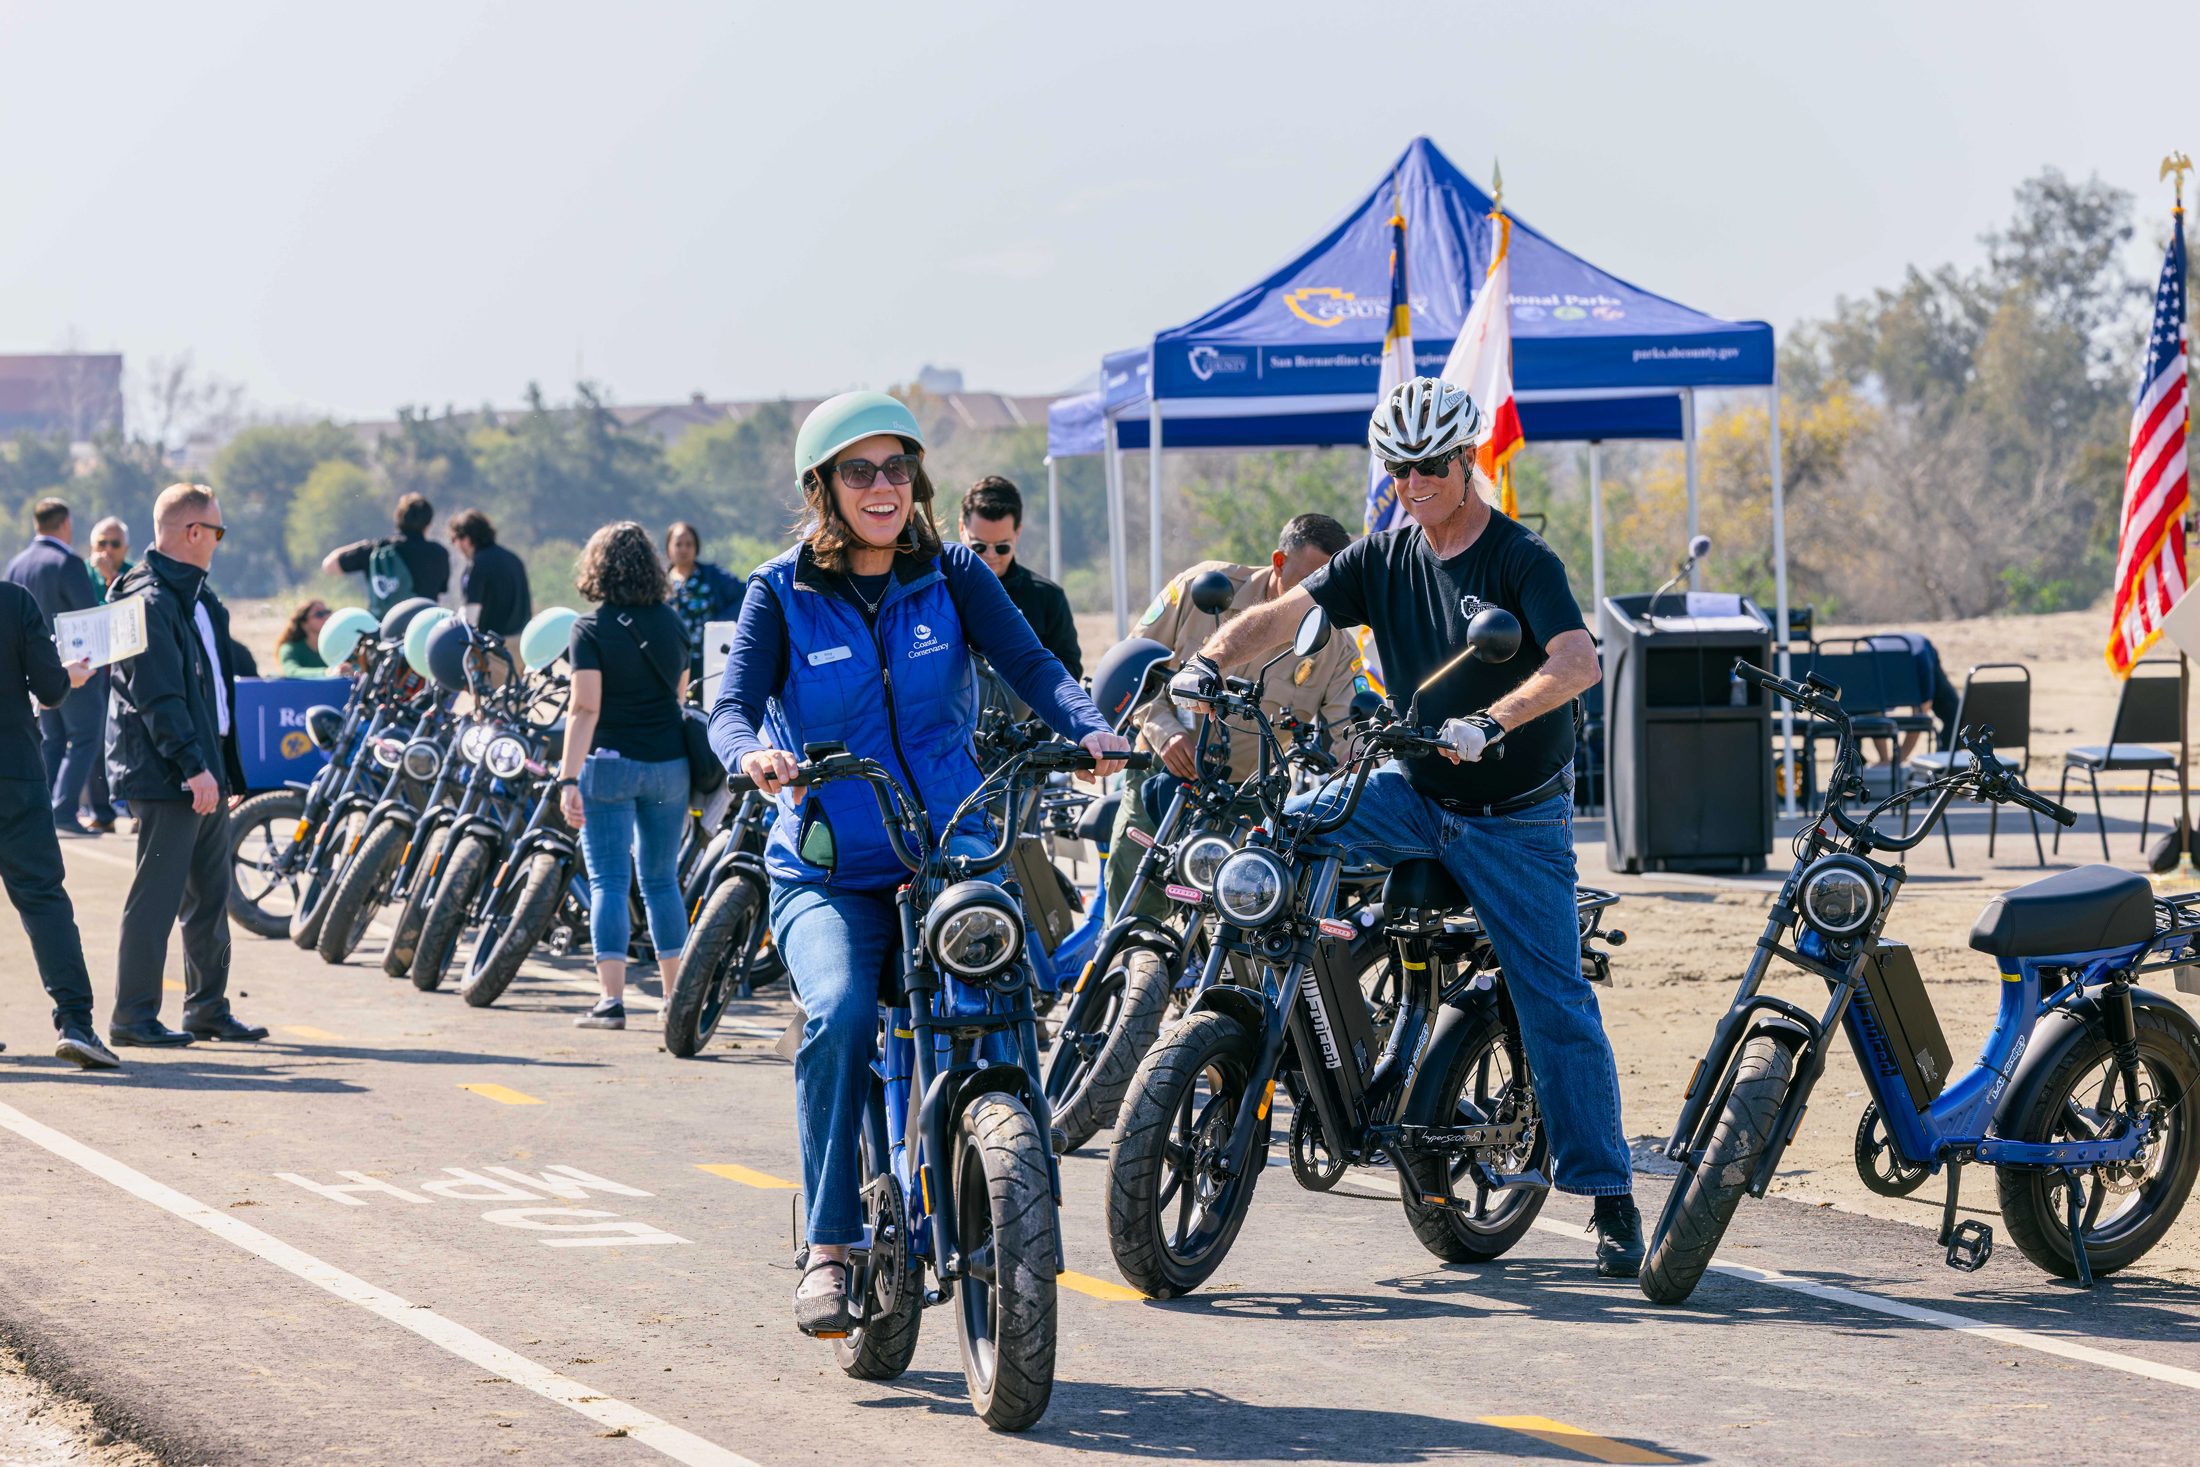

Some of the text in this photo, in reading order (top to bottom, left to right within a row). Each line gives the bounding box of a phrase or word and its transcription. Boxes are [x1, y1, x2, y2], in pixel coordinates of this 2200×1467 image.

[1318, 296, 1428, 319] COUNY
[1564, 294, 1622, 306] Parks
[1269, 355, 1293, 369] San
[1294, 354, 1359, 368] Bernardino
[913, 636, 938, 650] Coastal
[908, 643, 949, 659] Conservancy
[273, 1164, 657, 1206] MPH
